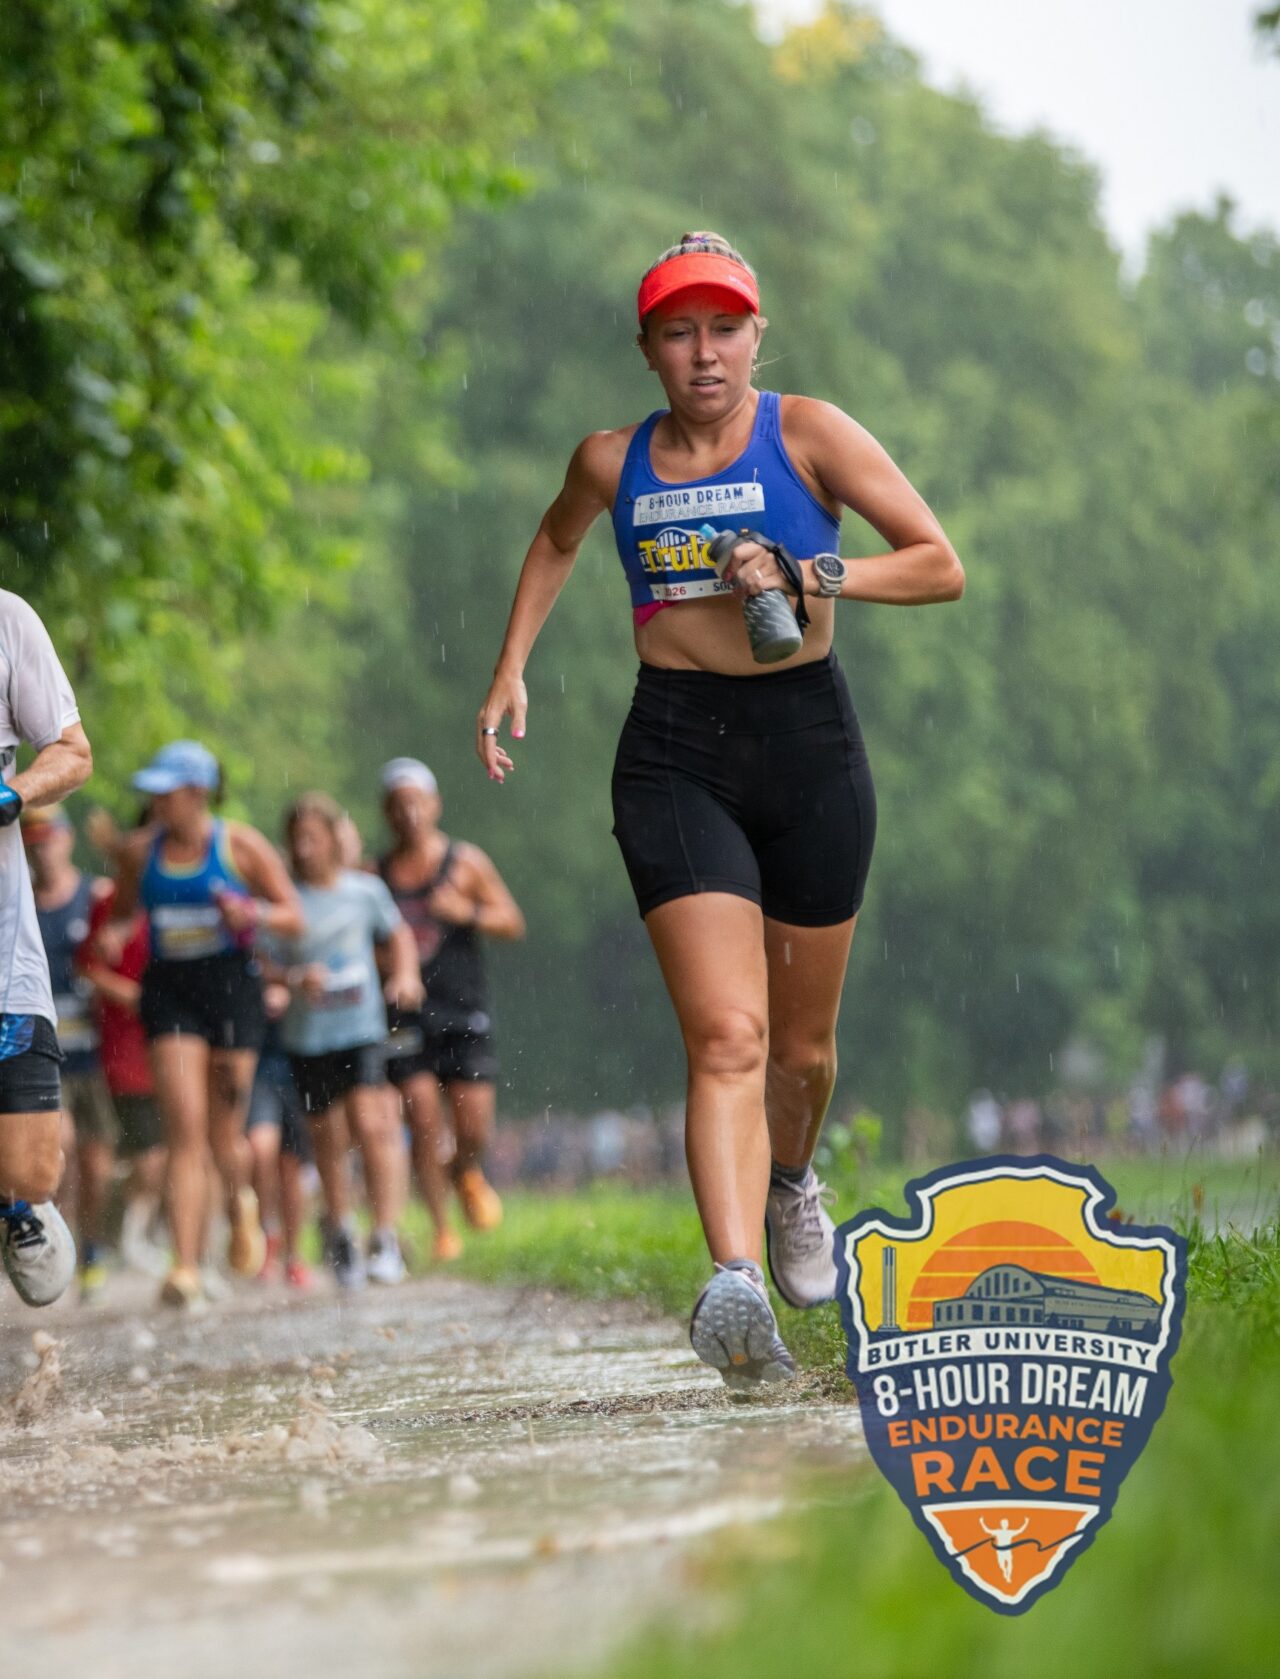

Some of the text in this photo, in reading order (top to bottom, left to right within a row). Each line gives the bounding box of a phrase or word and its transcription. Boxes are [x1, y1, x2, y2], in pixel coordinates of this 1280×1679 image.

[649, 486, 743, 510] 8-HOUR DREAM
[638, 499, 757, 523] ENDURANCE RACE
